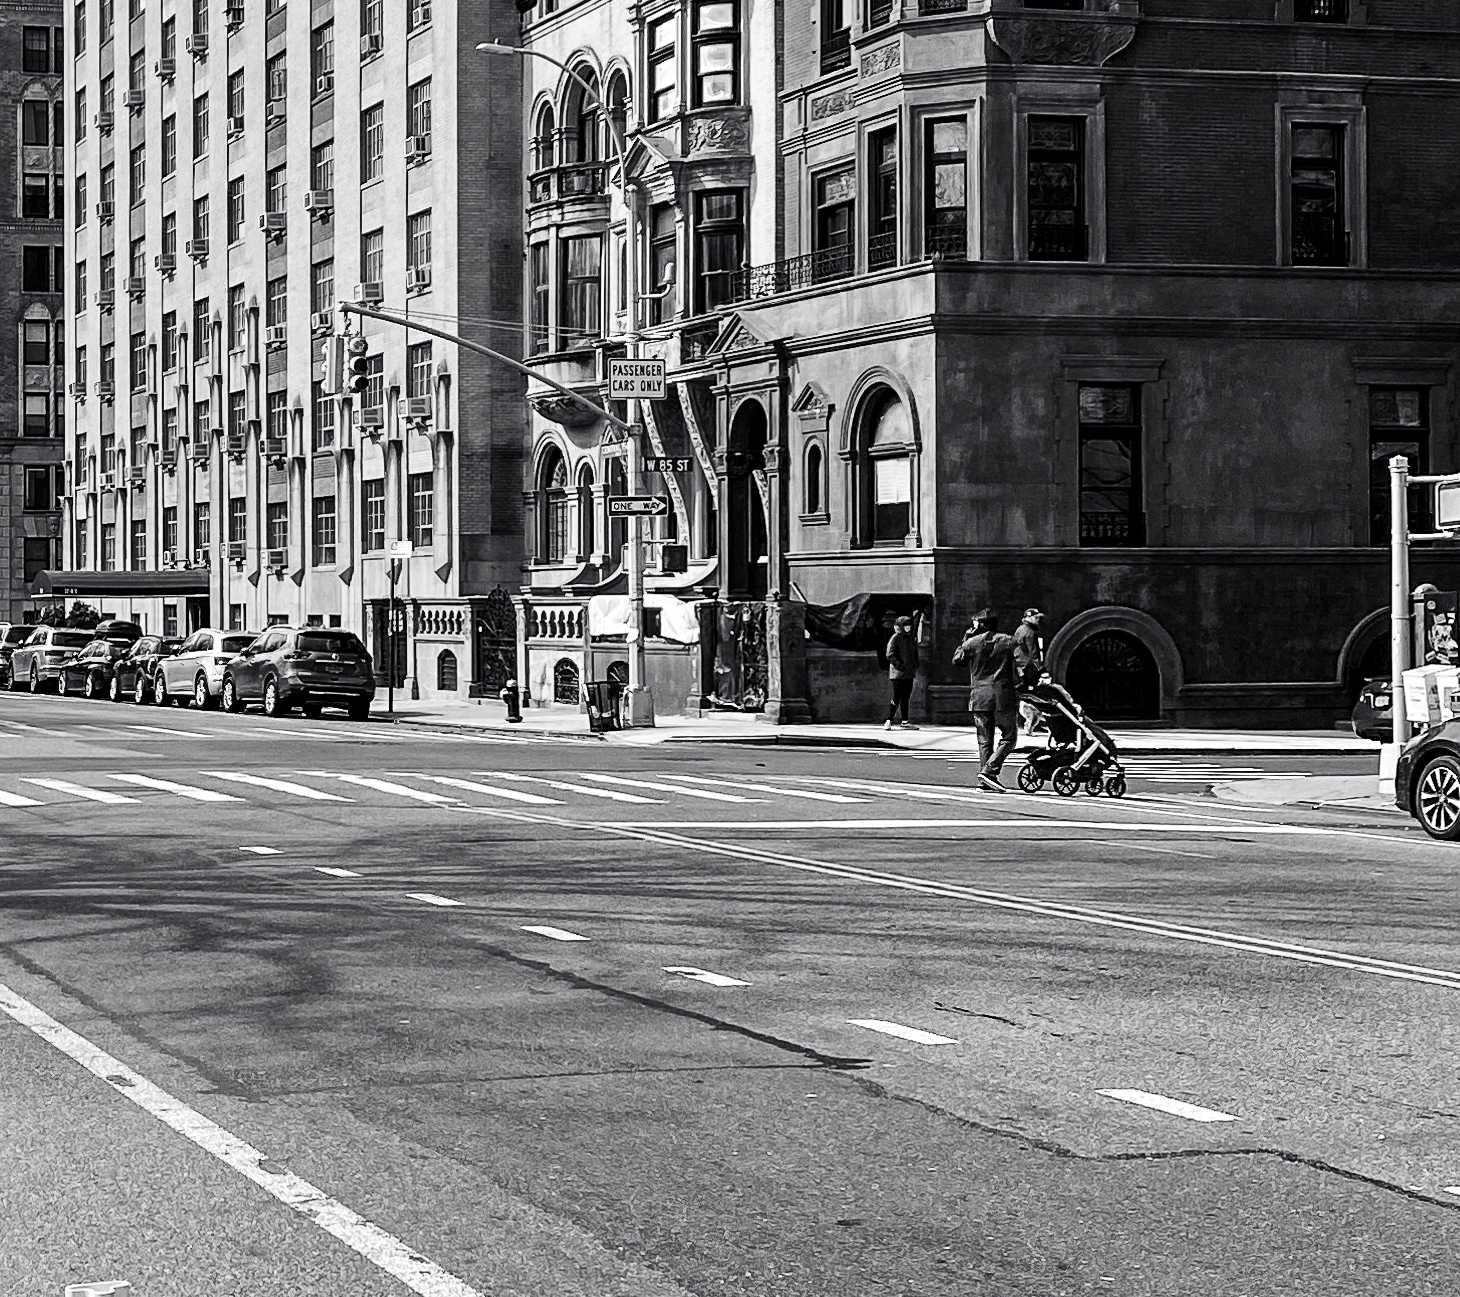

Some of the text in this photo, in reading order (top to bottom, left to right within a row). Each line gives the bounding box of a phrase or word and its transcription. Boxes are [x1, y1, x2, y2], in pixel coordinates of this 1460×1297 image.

[612, 364, 662, 377] PASSENGER
[612, 379, 663, 392] CARS ONLY
[647, 459, 690, 472] W 85 ST
[613, 502, 661, 511] ONE WAY
